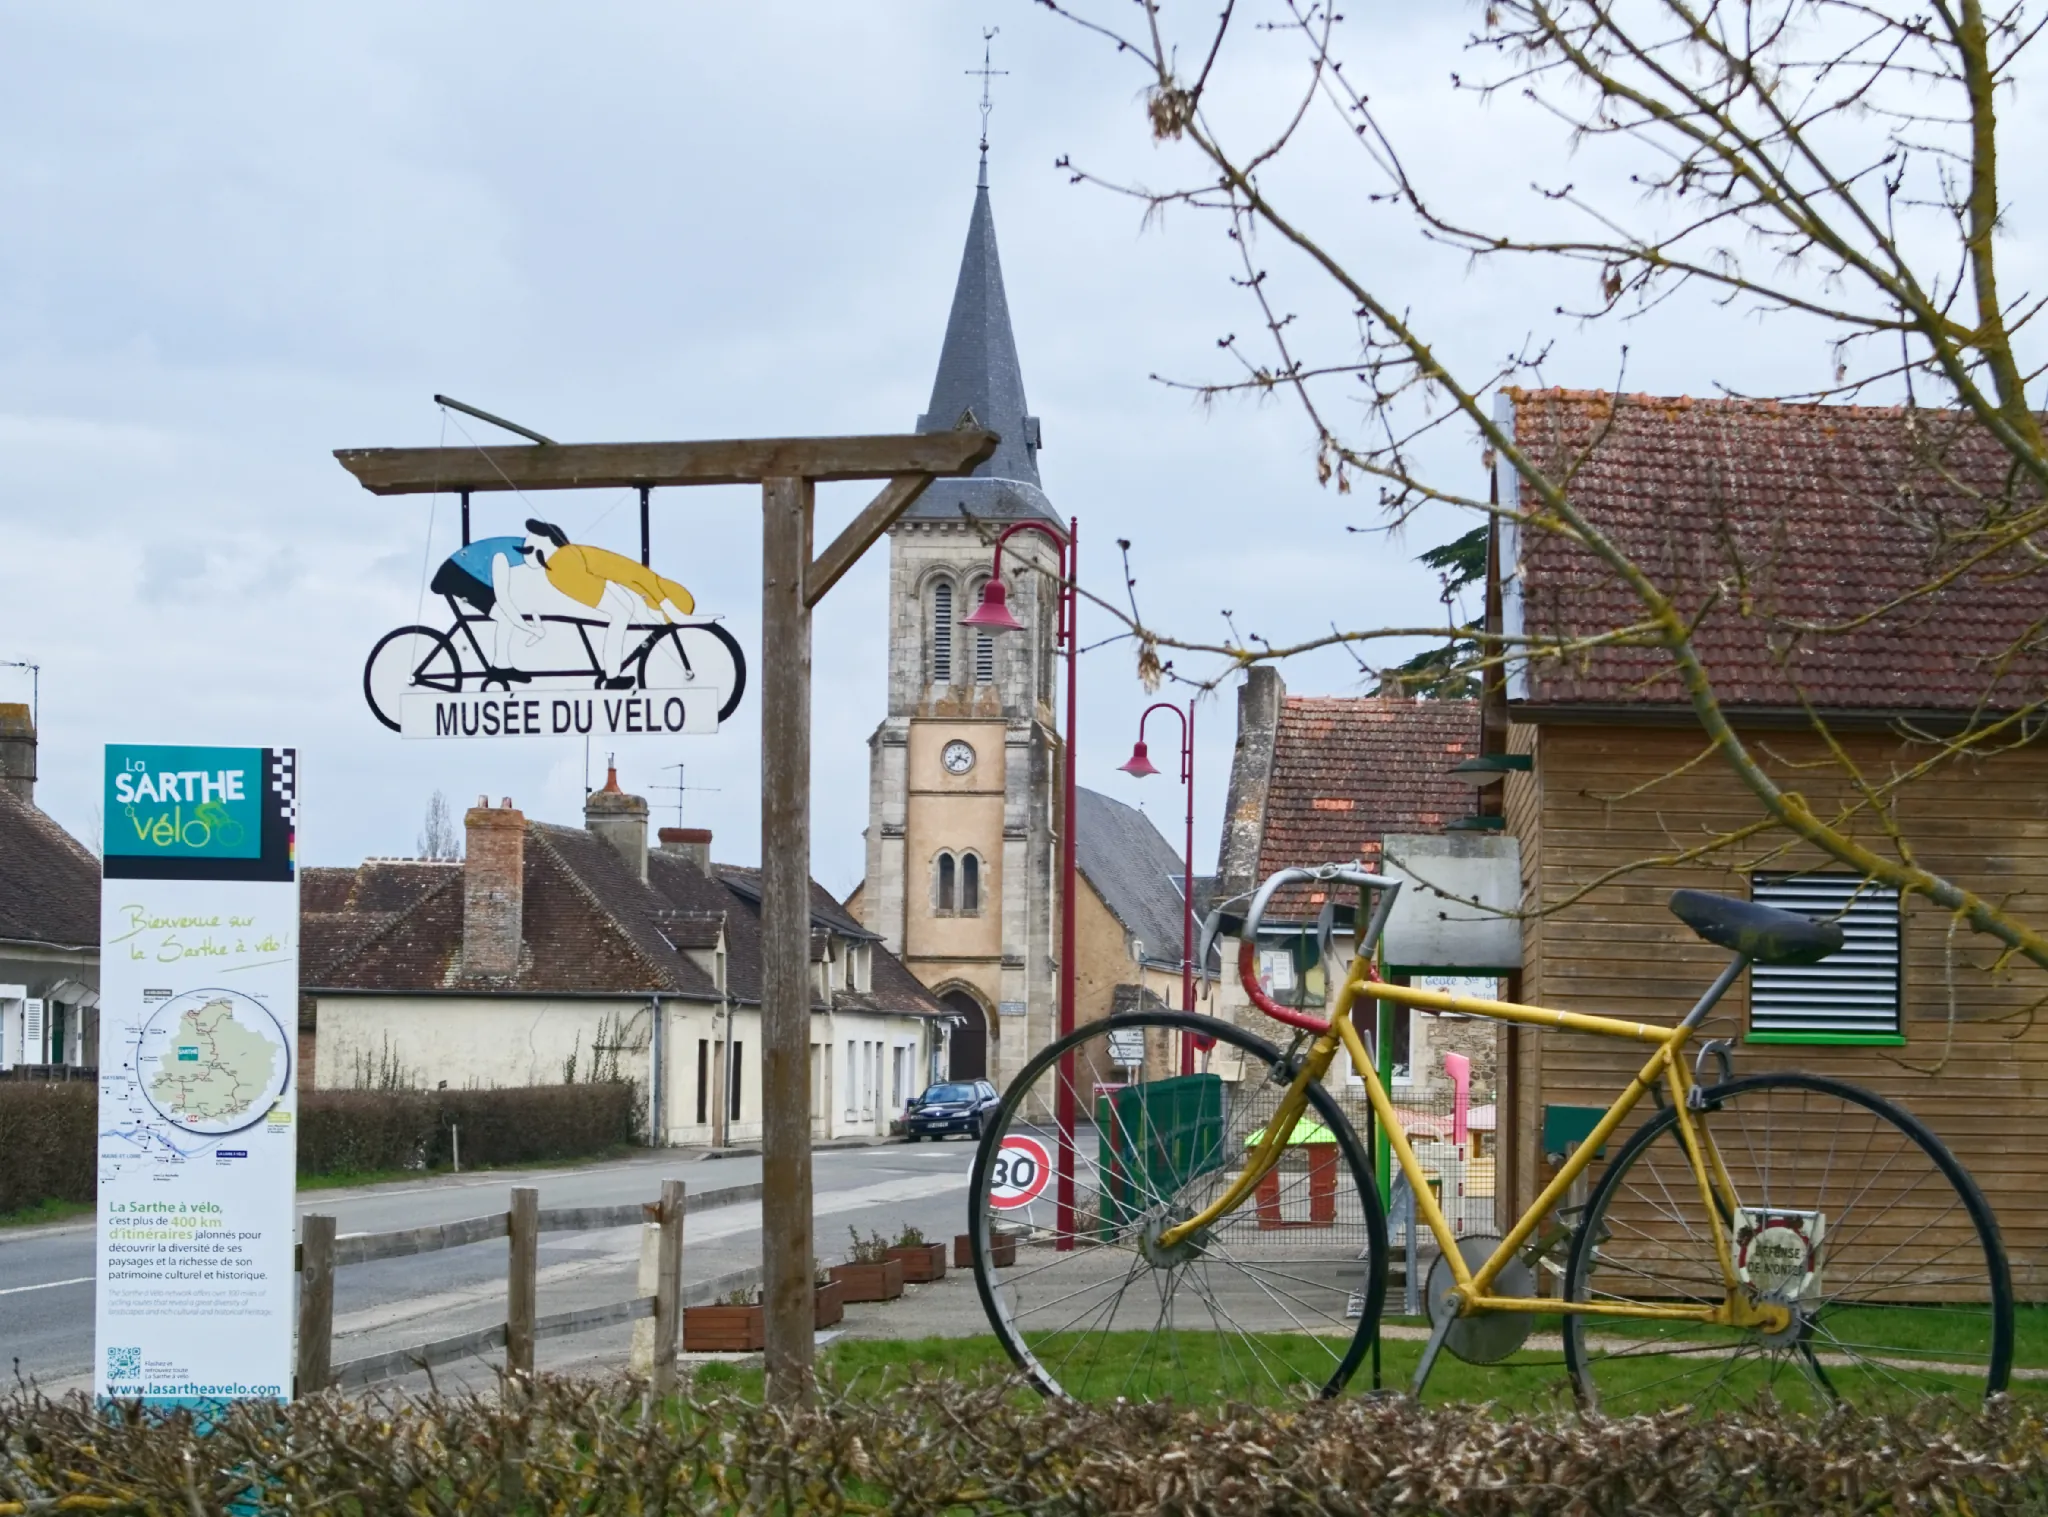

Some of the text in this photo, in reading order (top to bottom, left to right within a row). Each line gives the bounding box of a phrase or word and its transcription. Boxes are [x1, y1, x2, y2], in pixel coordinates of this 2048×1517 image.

[436, 690, 685, 735] MUSÉE DU VÉLO
[126, 757, 145, 772] La
[115, 769, 246, 804] SARTHE
[133, 805, 211, 848] vélo
[108, 904, 256, 944] Bienvenue sur
[131, 942, 147, 960] la
[157, 934, 229, 962] Sarthe
[235, 938, 248, 953] à
[991, 1157, 1035, 1188] 30
[109, 1200, 223, 1214] La Sarthe à vélo,
[108, 1215, 222, 1228] c'est plus de 400 km
[109, 1227, 262, 1242] d'itinéraires jalonnés pour
[108, 1243, 243, 1253] découvrir la diversité de ses
[108, 1256, 253, 1268] paysages et la richesse de son
[108, 1270, 268, 1281] patrimoine culturel et historique.
[106, 1382, 281, 1395] www.lasartheavelo.com
